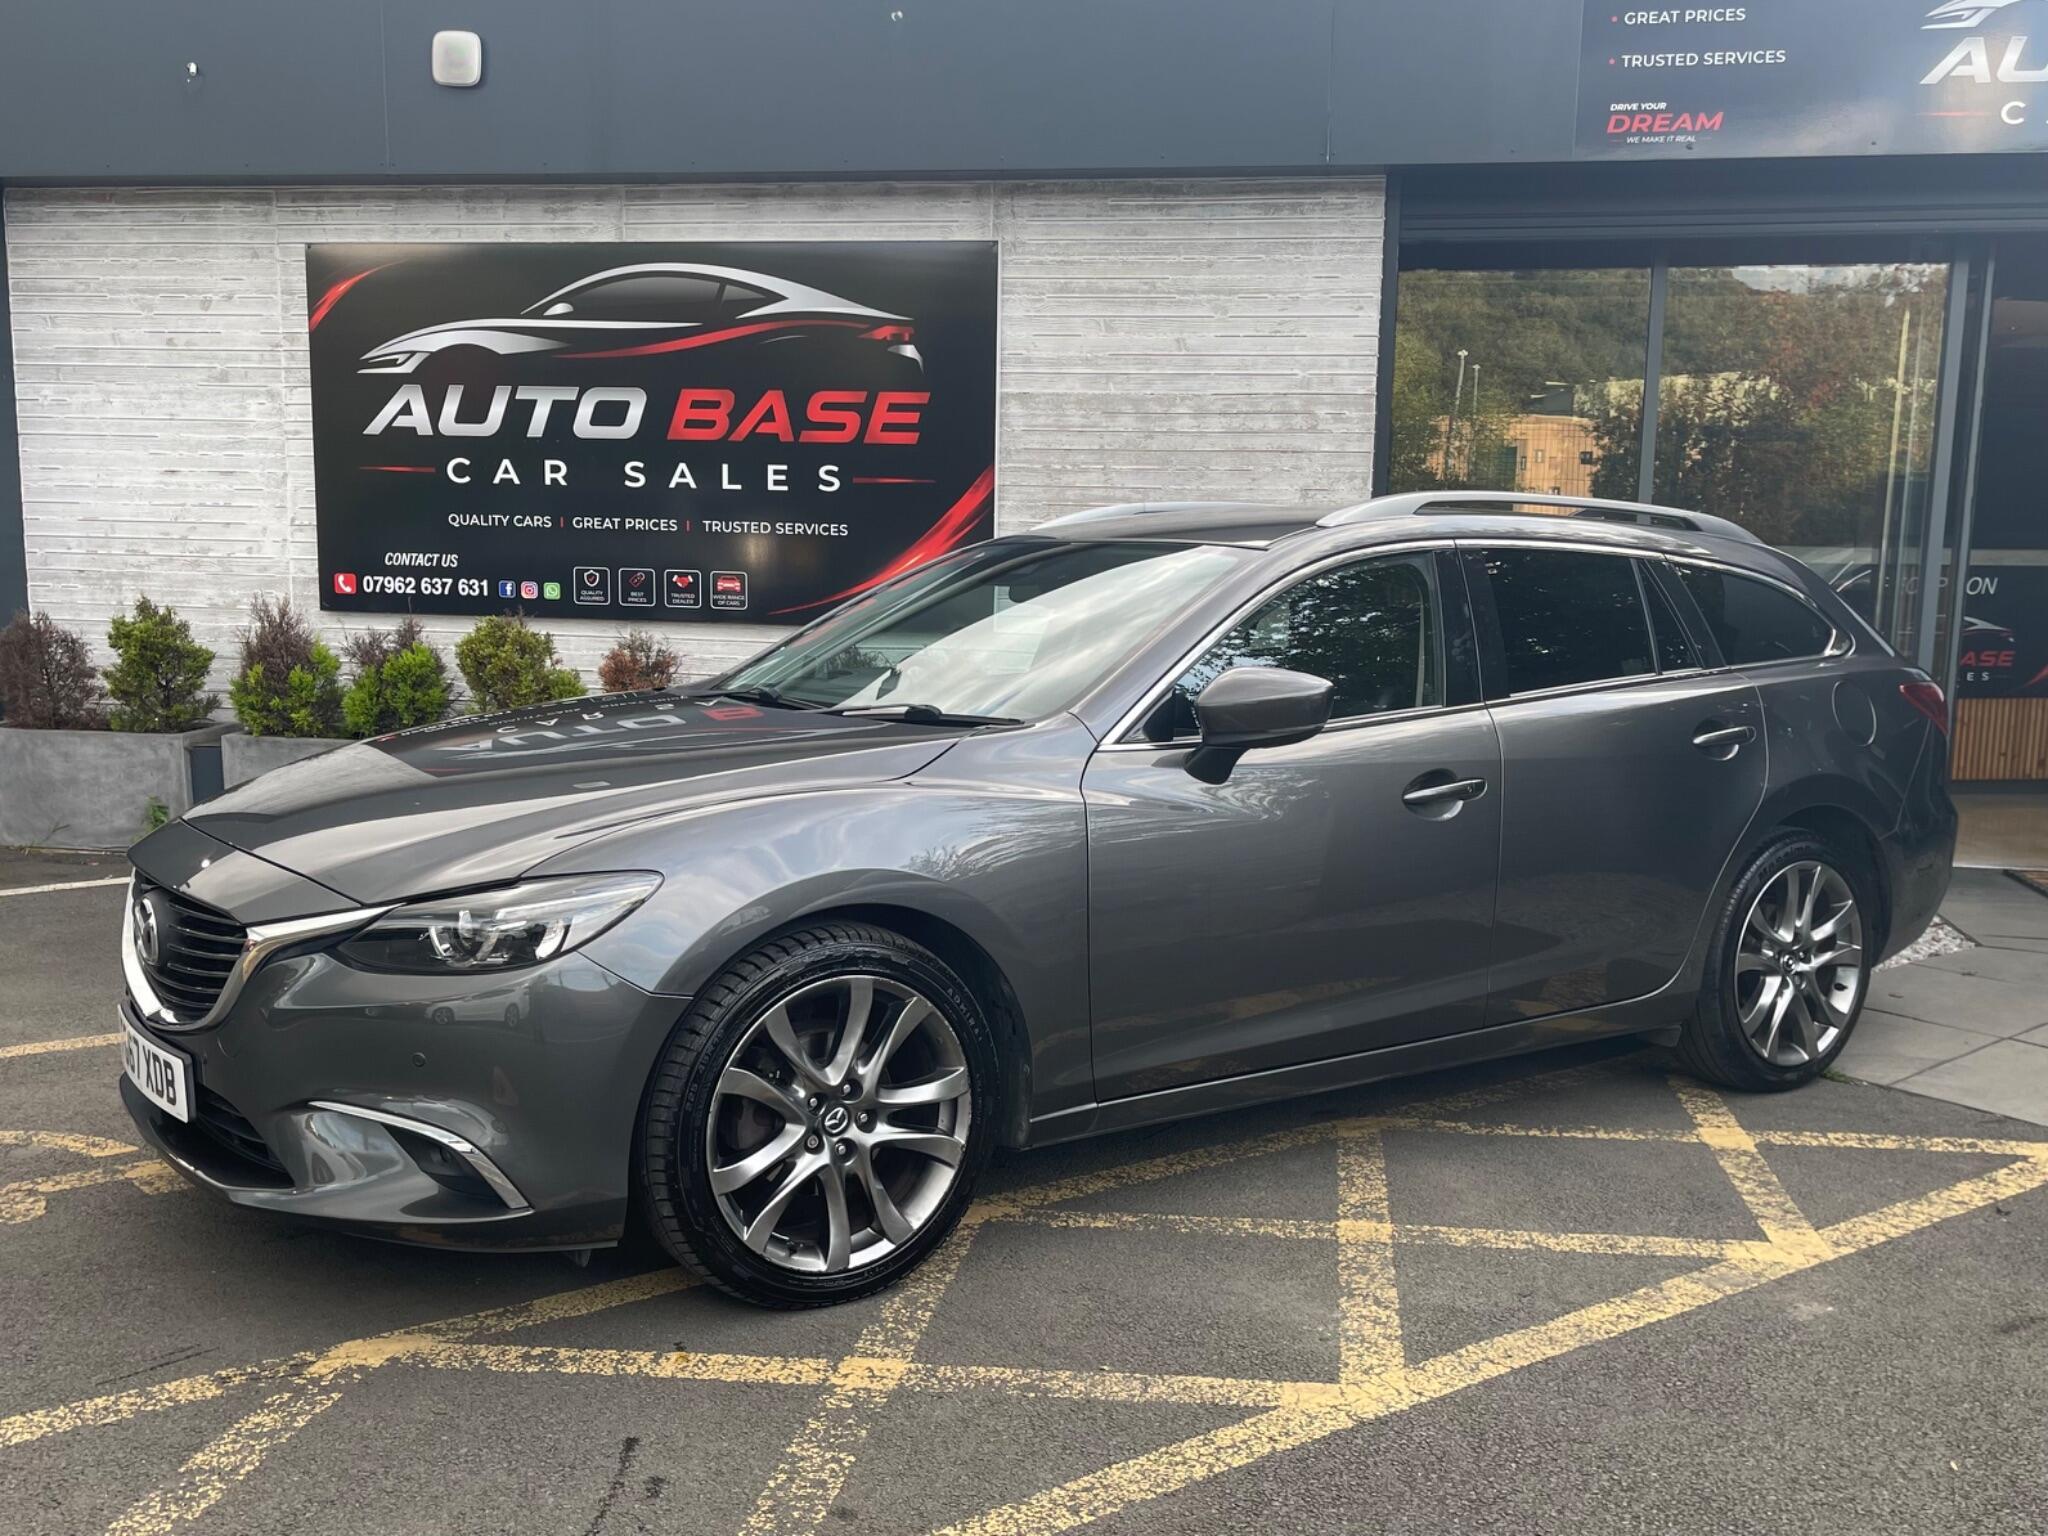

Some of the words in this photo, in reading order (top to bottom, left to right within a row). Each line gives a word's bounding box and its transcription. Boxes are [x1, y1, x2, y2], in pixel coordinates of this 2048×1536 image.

[1624, 10, 1680, 25] GREAT
[1685, 8, 1746, 23] PRICES
[1621, 53, 1699, 68] TRUSTED
[1703, 50, 1786, 65] SERVICES
[1610, 103, 1638, 111] DRIVE
[1640, 102, 1667, 110] YOUR
[1607, 112, 1724, 133] DREAM
[1626, 136, 1640, 144] WE
[1641, 135, 1665, 143] MAKE
[1666, 135, 1674, 143] IT
[362, 384, 647, 439] AUTO
[666, 388, 931, 445] BASE
[446, 457, 568, 486] CAR
[624, 461, 841, 492] SALES
[448, 513, 510, 528] QUALITY
[513, 515, 553, 528] CARS
[572, 516, 621, 530] GREAT
[625, 518, 678, 531] PRICES
[702, 520, 771, 534] TRUSTED
[775, 521, 849, 536] SERVICES
[384, 552, 440, 567] CONTACT
[441, 554, 459, 568] US
[362, 575, 416, 594] 07962
[420, 577, 453, 595] 637
[458, 579, 488, 597] 631
[1959, 650, 2016, 668] ASE
